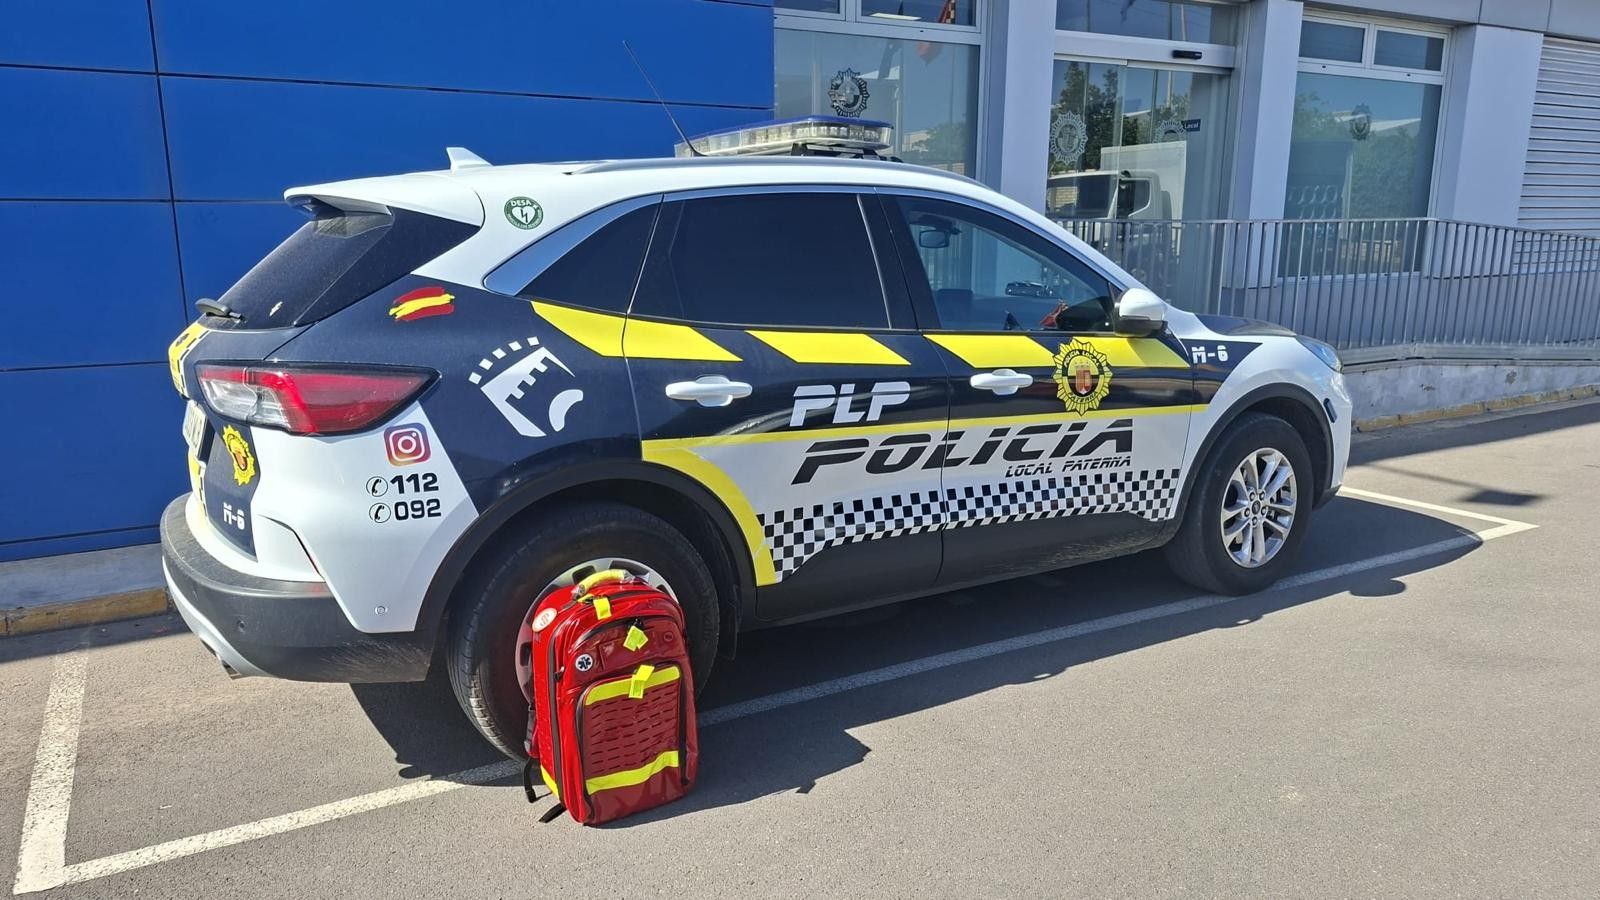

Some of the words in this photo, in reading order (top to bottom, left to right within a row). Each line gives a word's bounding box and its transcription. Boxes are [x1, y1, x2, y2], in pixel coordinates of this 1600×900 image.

[1191, 345, 1229, 364] M-6
[789, 381, 911, 427] PLP
[790, 418, 1132, 485] POLICIA
[1005, 462, 1053, 478] LOCAL
[1062, 456, 1131, 472] PATERNA
[390, 472, 439, 494] 112
[223, 502, 245, 530] M-6
[394, 498, 442, 520] 092
